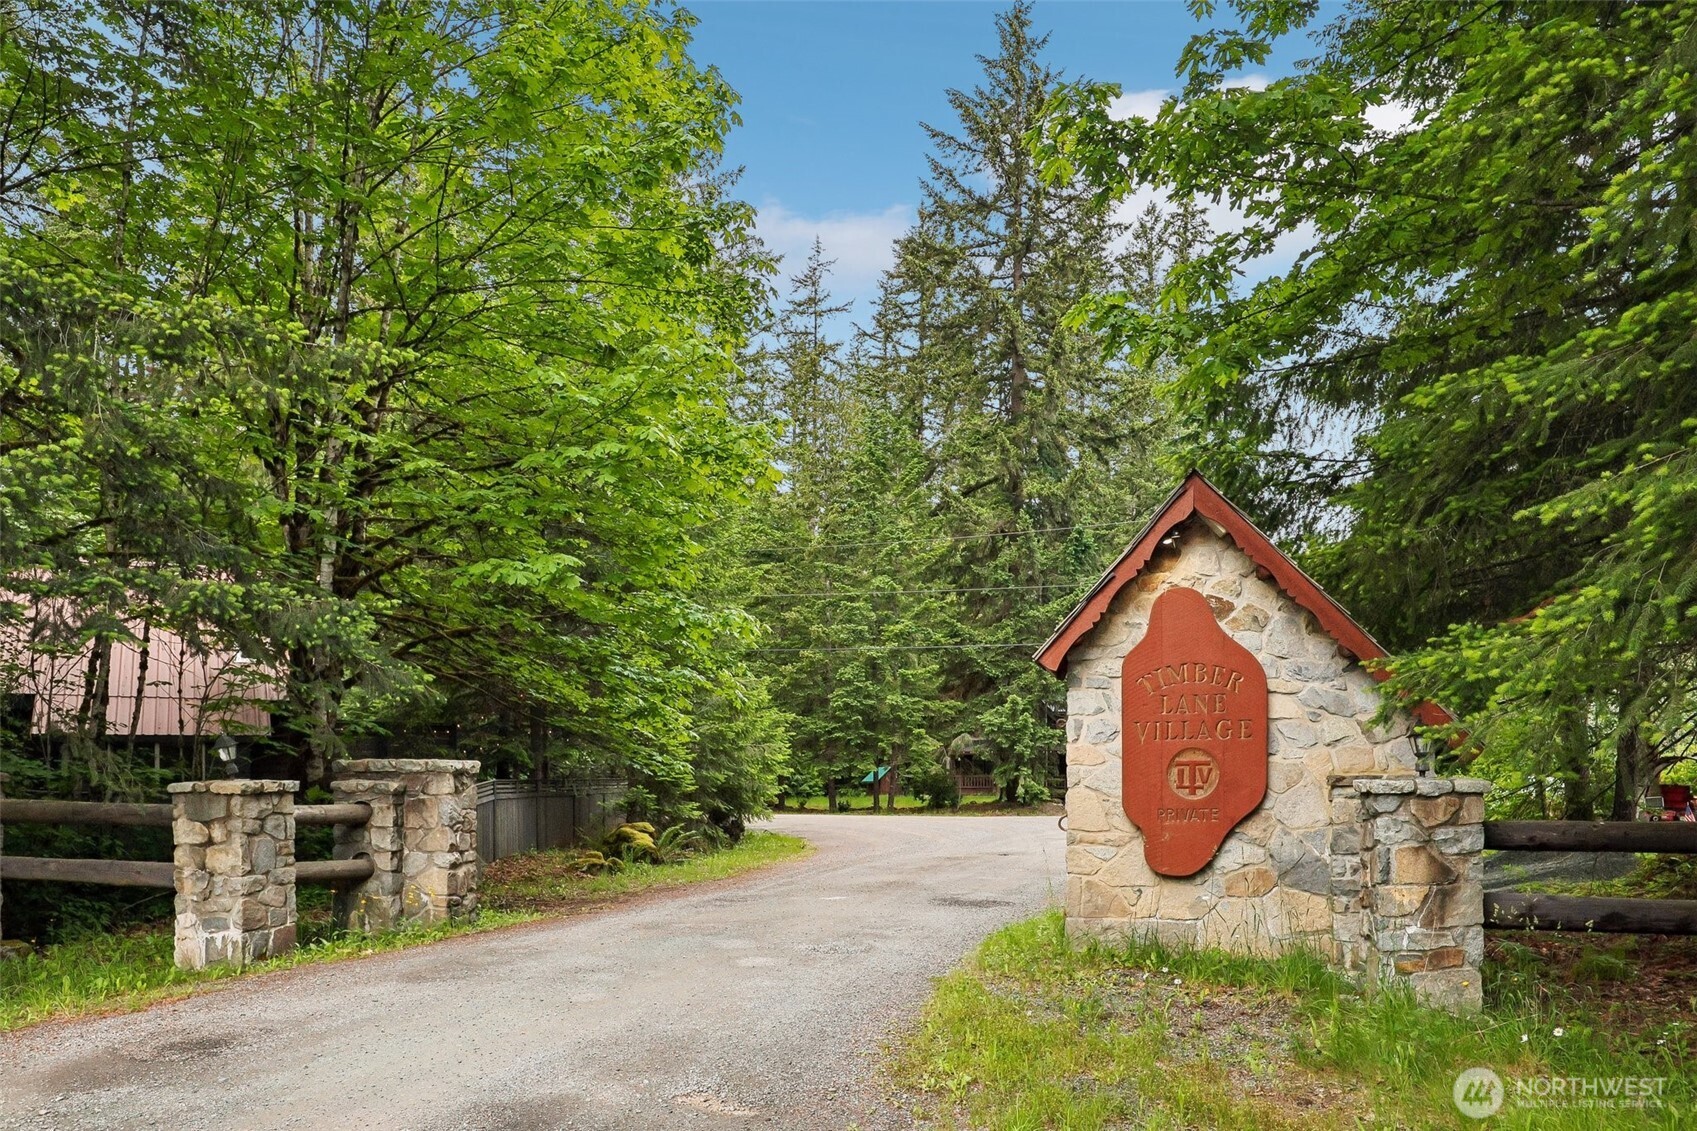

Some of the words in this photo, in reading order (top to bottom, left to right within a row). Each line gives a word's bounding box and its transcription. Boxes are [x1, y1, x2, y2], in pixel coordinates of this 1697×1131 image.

[1136, 662, 1245, 696] TIMBER
[1160, 693, 1227, 716] LANE
[1134, 719, 1253, 745] VILLAGE
[1157, 808, 1220, 823] PRIVATE
